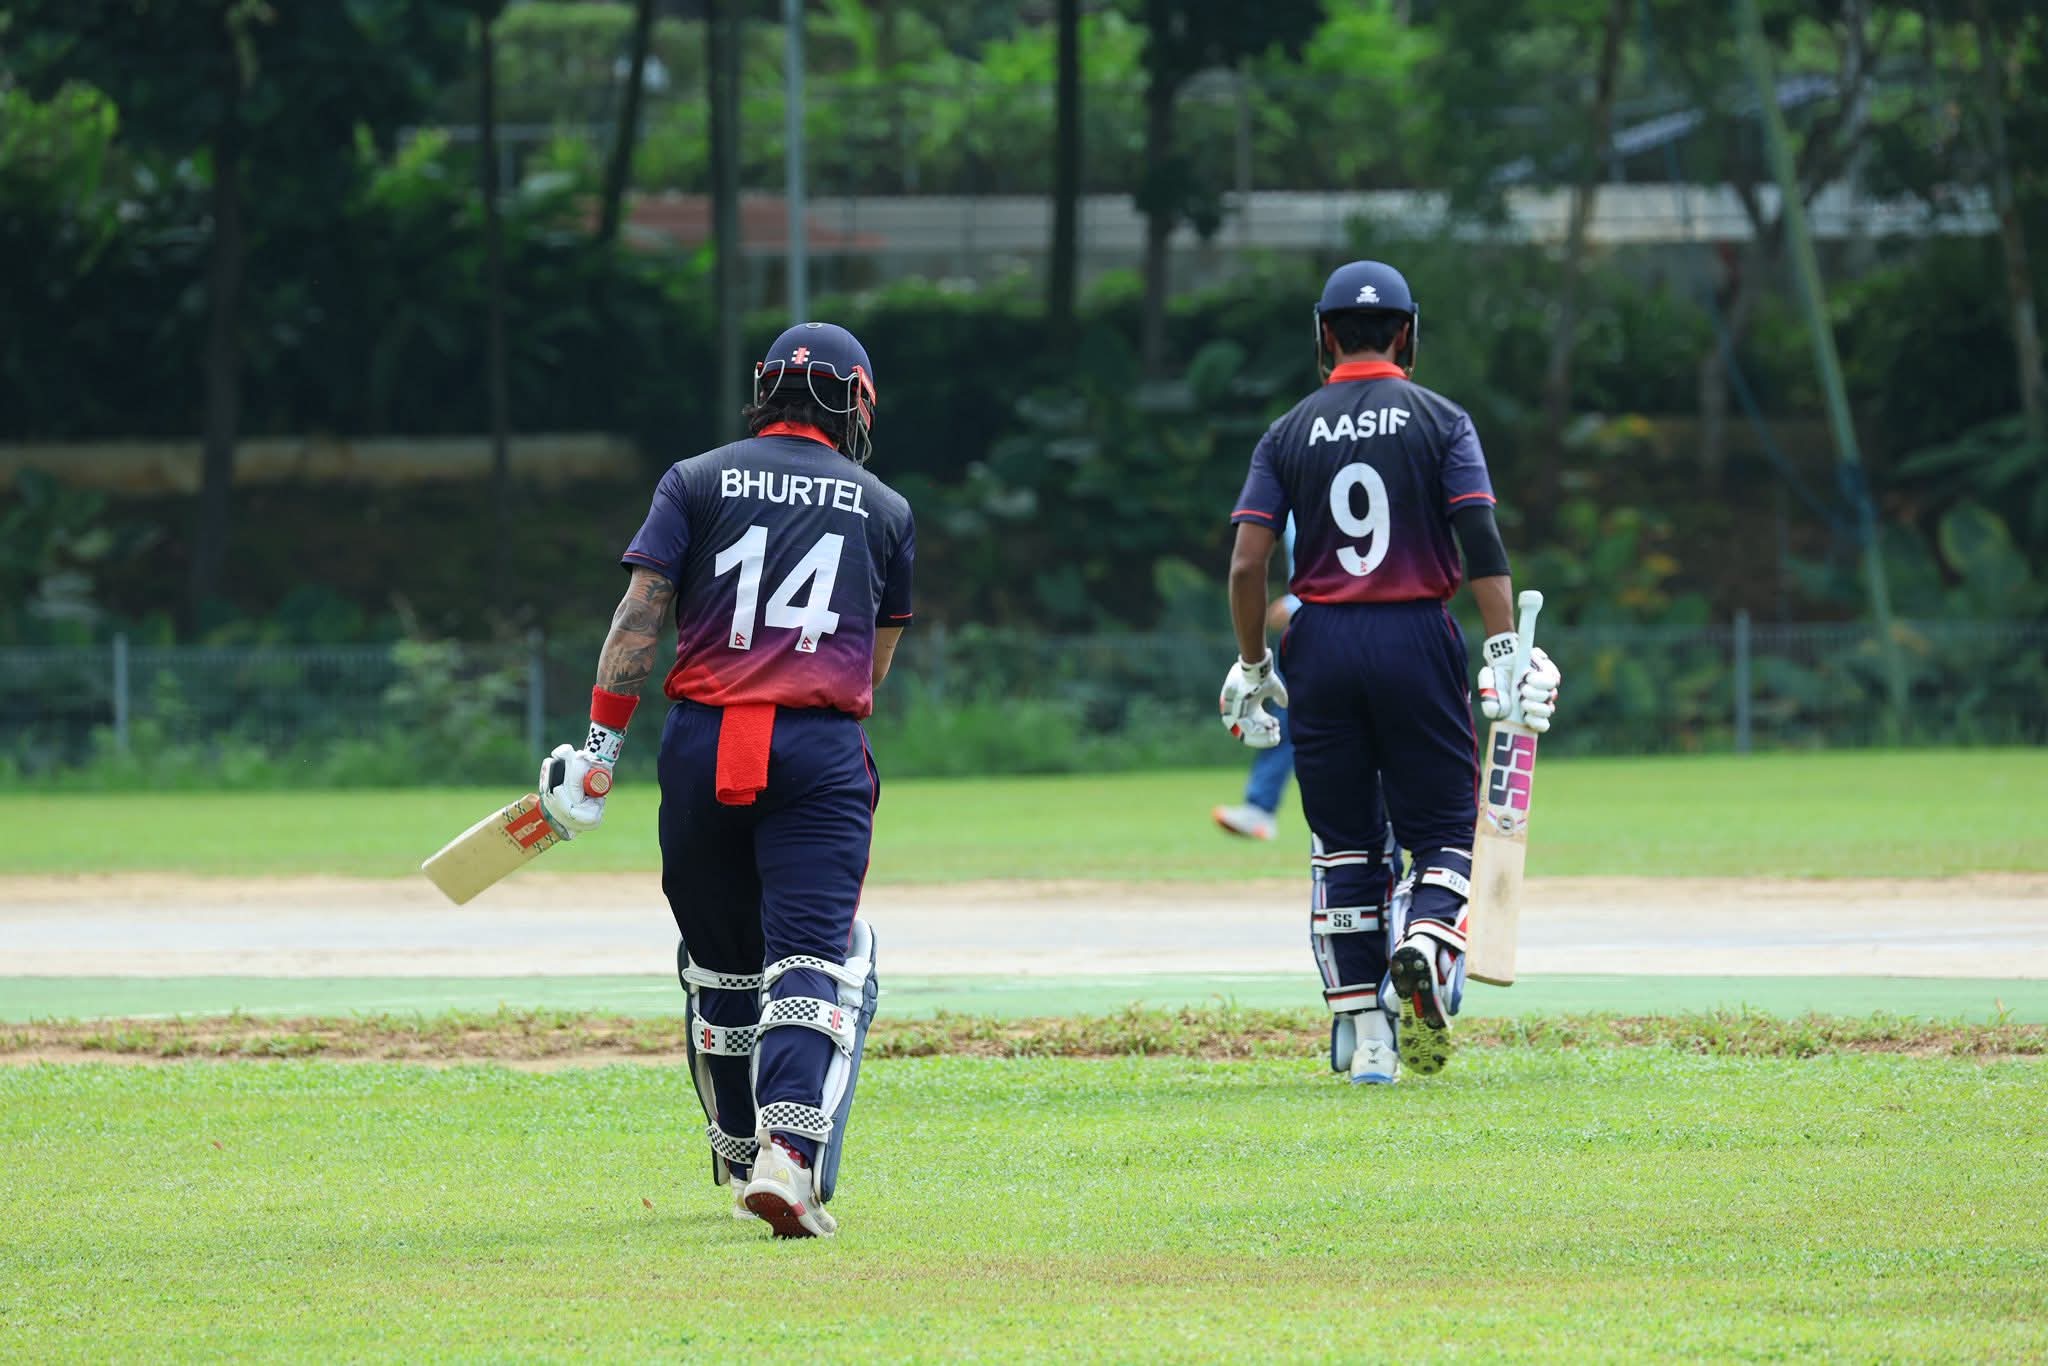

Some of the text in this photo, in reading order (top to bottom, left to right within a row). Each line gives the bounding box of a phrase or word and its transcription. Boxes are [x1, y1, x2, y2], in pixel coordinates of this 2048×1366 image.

[1308, 407, 1411, 447] AASIF
[721, 468, 870, 518] BHURTEL
[1329, 462, 1391, 577] 9
[714, 524, 845, 654] 14
[1489, 639, 1514, 659] SS
[1333, 913, 1353, 928] SS
